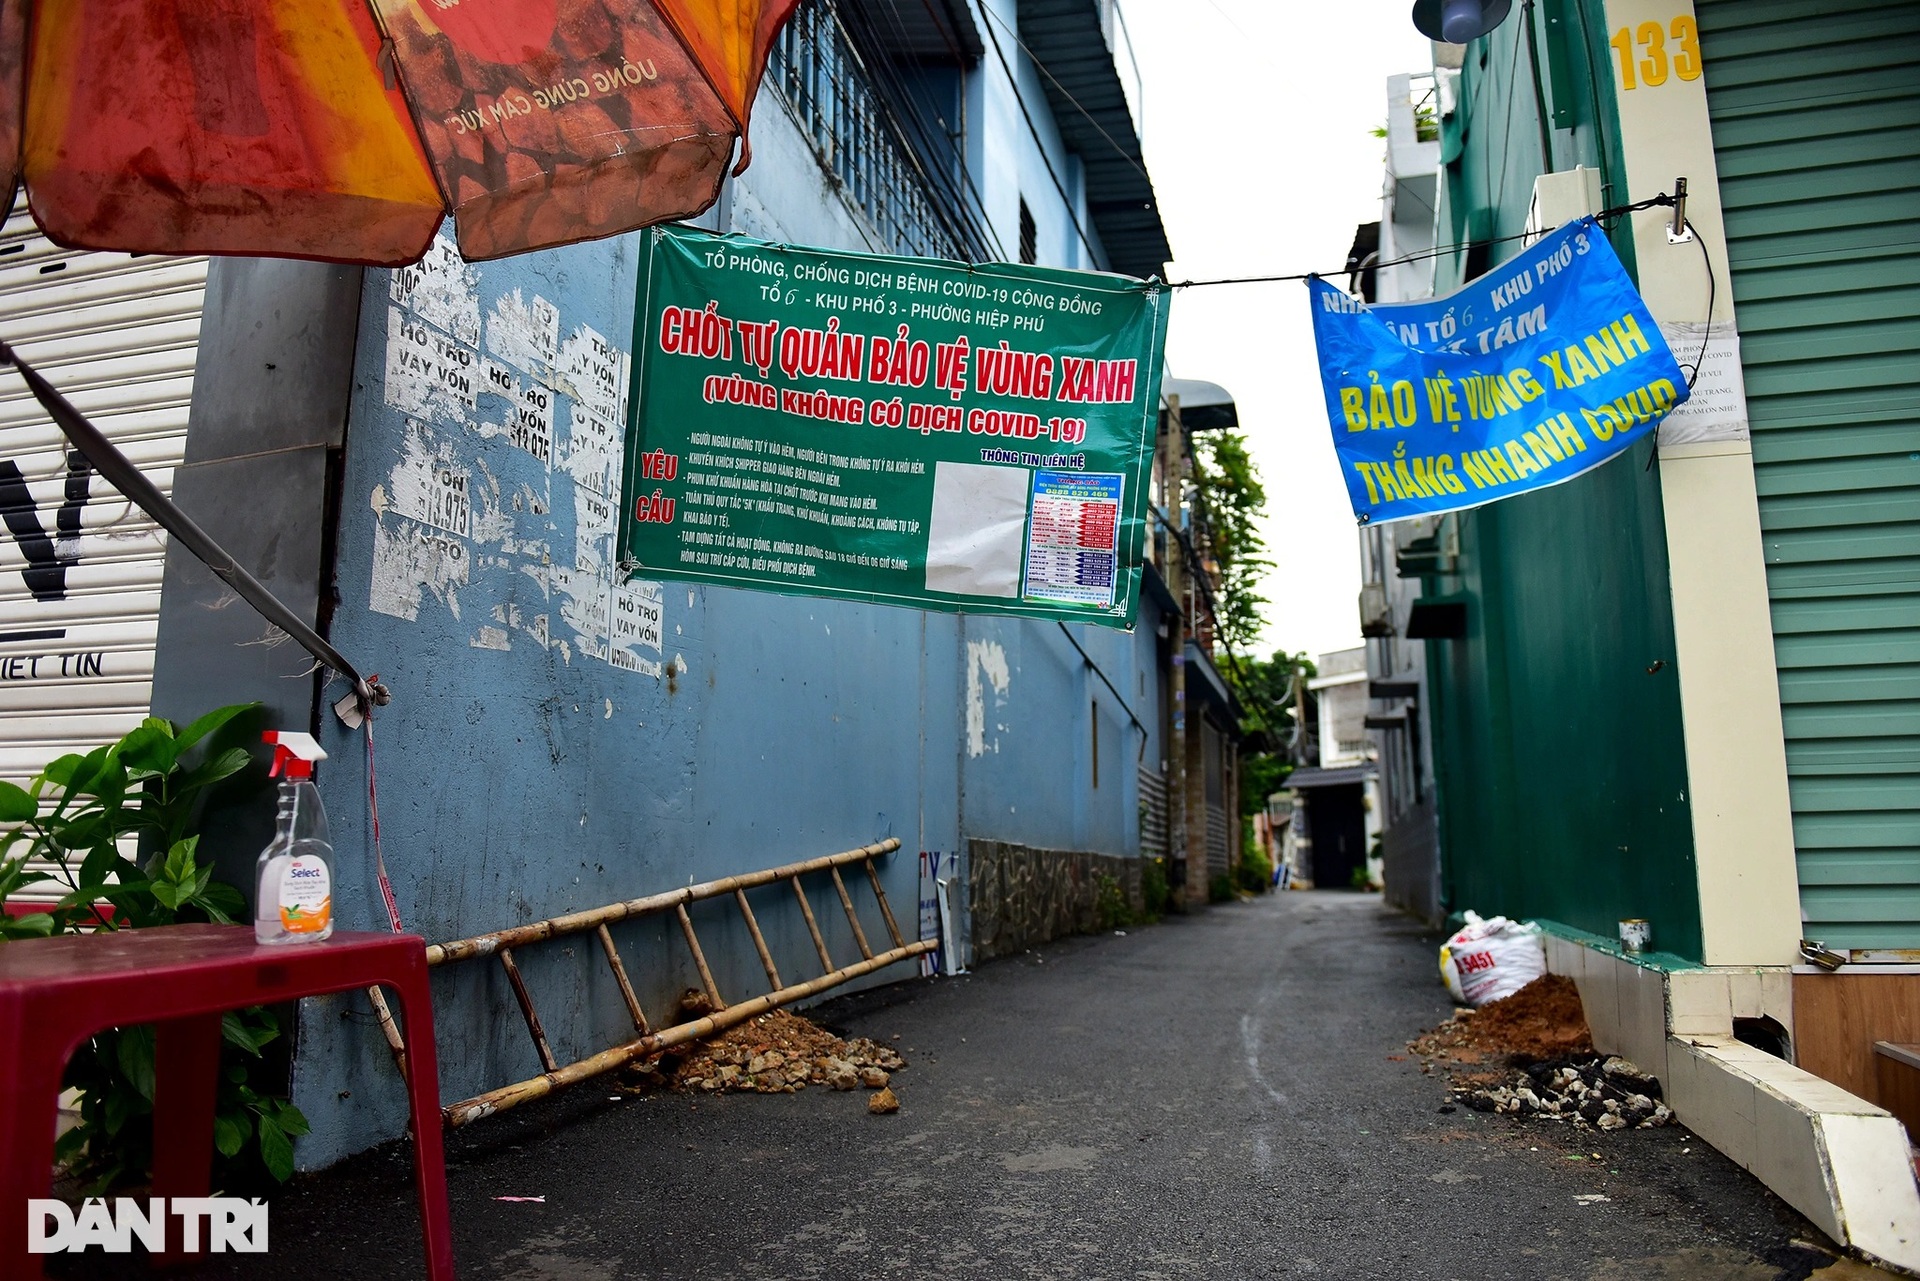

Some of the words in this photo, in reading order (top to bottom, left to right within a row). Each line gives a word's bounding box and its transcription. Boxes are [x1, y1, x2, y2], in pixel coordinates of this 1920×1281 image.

[1610, 15, 1702, 91] 133
[704, 246, 725, 269] TỔ
[729, 254, 789, 280] PHÒNG,
[793, 260, 850, 284] CHỐNG
[854, 270, 892, 290] DỊCH
[896, 273, 939, 294] BỆNH
[942, 280, 1008, 303] COVID-19
[1012, 288, 1055, 310] CỘNG
[1058, 293, 1103, 315] ĐỒNG
[1425, 307, 1456, 342] TỔ
[1462, 305, 1473, 327] 6
[1490, 270, 1533, 312] KHU
[1535, 235, 1573, 285] PHỐ
[1575, 233, 1591, 256] 3
[760, 280, 781, 303] TỔ
[785, 288, 799, 306] 6
[815, 293, 848, 311] KHU
[852, 293, 886, 315] PHỐ
[888, 301, 897, 316] 3
[911, 301, 971, 324] PHƯỜNG
[975, 309, 1009, 330] HIỆP
[1013, 315, 1045, 333] PHÚ
[1476, 303, 1548, 355] TÂM
[659, 299, 733, 360] CHỐT
[737, 319, 779, 379] TỰ
[779, 315, 865, 381] QUẢN
[868, 323, 929, 388] BẢO
[935, 334, 971, 401] VỆ
[975, 340, 1054, 402] VÙNG
[1057, 355, 1138, 404] XANH
[1707, 351, 1733, 360] COVID
[438, 366, 470, 394] VỐN
[1339, 369, 1418, 434] BẢO
[1426, 369, 1463, 432] VỆ
[1463, 366, 1550, 421] VÙNG
[1538, 313, 1651, 391] XANH
[519, 407, 547, 434] VỐN
[702, 373, 777, 410] (VÙNG
[781, 389, 865, 424] KHÔNG
[869, 397, 903, 427] CÓ
[907, 402, 965, 436] DỊCH
[967, 408, 1087, 445] COVID-19)
[641, 448, 679, 482] YÊU
[688, 450, 714, 467] KHUYẾN
[714, 454, 734, 469] KHÍCH
[734, 459, 762, 471] SHIPPER
[762, 461, 777, 474] GIAO
[778, 463, 794, 478] HÀNG
[794, 466, 807, 479] BÊN
[807, 468, 825, 483] NGOÀI
[690, 431, 711, 446] NGƯỜI
[711, 434, 731, 449] NGOÀI
[732, 436, 754, 451] KHÔNG
[754, 439, 764, 455] TỰ
[768, 441, 781, 455] VÀO
[796, 446, 815, 462] NGƯỜI
[815, 450, 829, 464] BÊN
[829, 454, 849, 469] TRONG
[850, 456, 871, 471] KHÔNG
[872, 458, 882, 474] TỰ
[886, 460, 896, 472] RA
[980, 448, 1019, 466] THÔNG
[1021, 452, 1040, 467] TIN
[1042, 452, 1067, 469] LIÊN
[1068, 452, 1085, 471] HỆ
[1353, 442, 1466, 506] THẮNG
[1462, 414, 1589, 489] NHANH
[635, 488, 676, 524] CẦU
[686, 472, 704, 486] PHUN
[741, 476, 760, 491] HÀNG
[760, 479, 773, 493] HÓA
[773, 482, 784, 497] TẠI
[783, 481, 799, 497] CHỐT
[799, 487, 819, 503] TRƯỚC
[818, 492, 829, 504] KHI
[829, 494, 849, 509] MANG
[849, 494, 862, 509] VÀO
[683, 511, 699, 524] KHAI
[699, 511, 713, 526] BÁO
[713, 515, 718, 526] Y
[685, 490, 702, 504] TUÂN
[702, 490, 715, 506] THỦ
[715, 494, 729, 508] QUY
[729, 493, 742, 509] TẮC
[775, 502, 796, 518] TRANG,
[830, 511, 857, 528] KHOẢNG
[857, 514, 876, 531] CÁCH,
[876, 516, 898, 532] KHÔNG
[898, 521, 908, 535] TỤ
[907, 519, 921, 535] TẬP,
[680, 548, 695, 563] HÔM
[695, 552, 710, 565] SAU
[766, 556, 782, 573] PHỐI
[782, 562, 798, 578] DỊCH
[798, 563, 817, 579] BỆNH.
[681, 530, 695, 545] TẠM
[714, 531, 727, 547] TẤT
[726, 532, 736, 548] CẢ
[736, 536, 753, 552] HOẠT
[753, 536, 772, 554] ĐỘNG,
[773, 539, 794, 554] KHÔNG
[794, 543, 804, 556] RA
[804, 543, 824, 560] ĐƯỜNG
[824, 550, 837, 562] SAU
[837, 552, 845, 562] 18
[870, 556, 879, 567] 06
[890, 557, 908, 571] SÁNG
[616, 617, 636, 636] VAY
[638, 624, 658, 644] VỐN
[637, 604, 658, 626] TRỢ
[291, 867, 321, 879] Select
